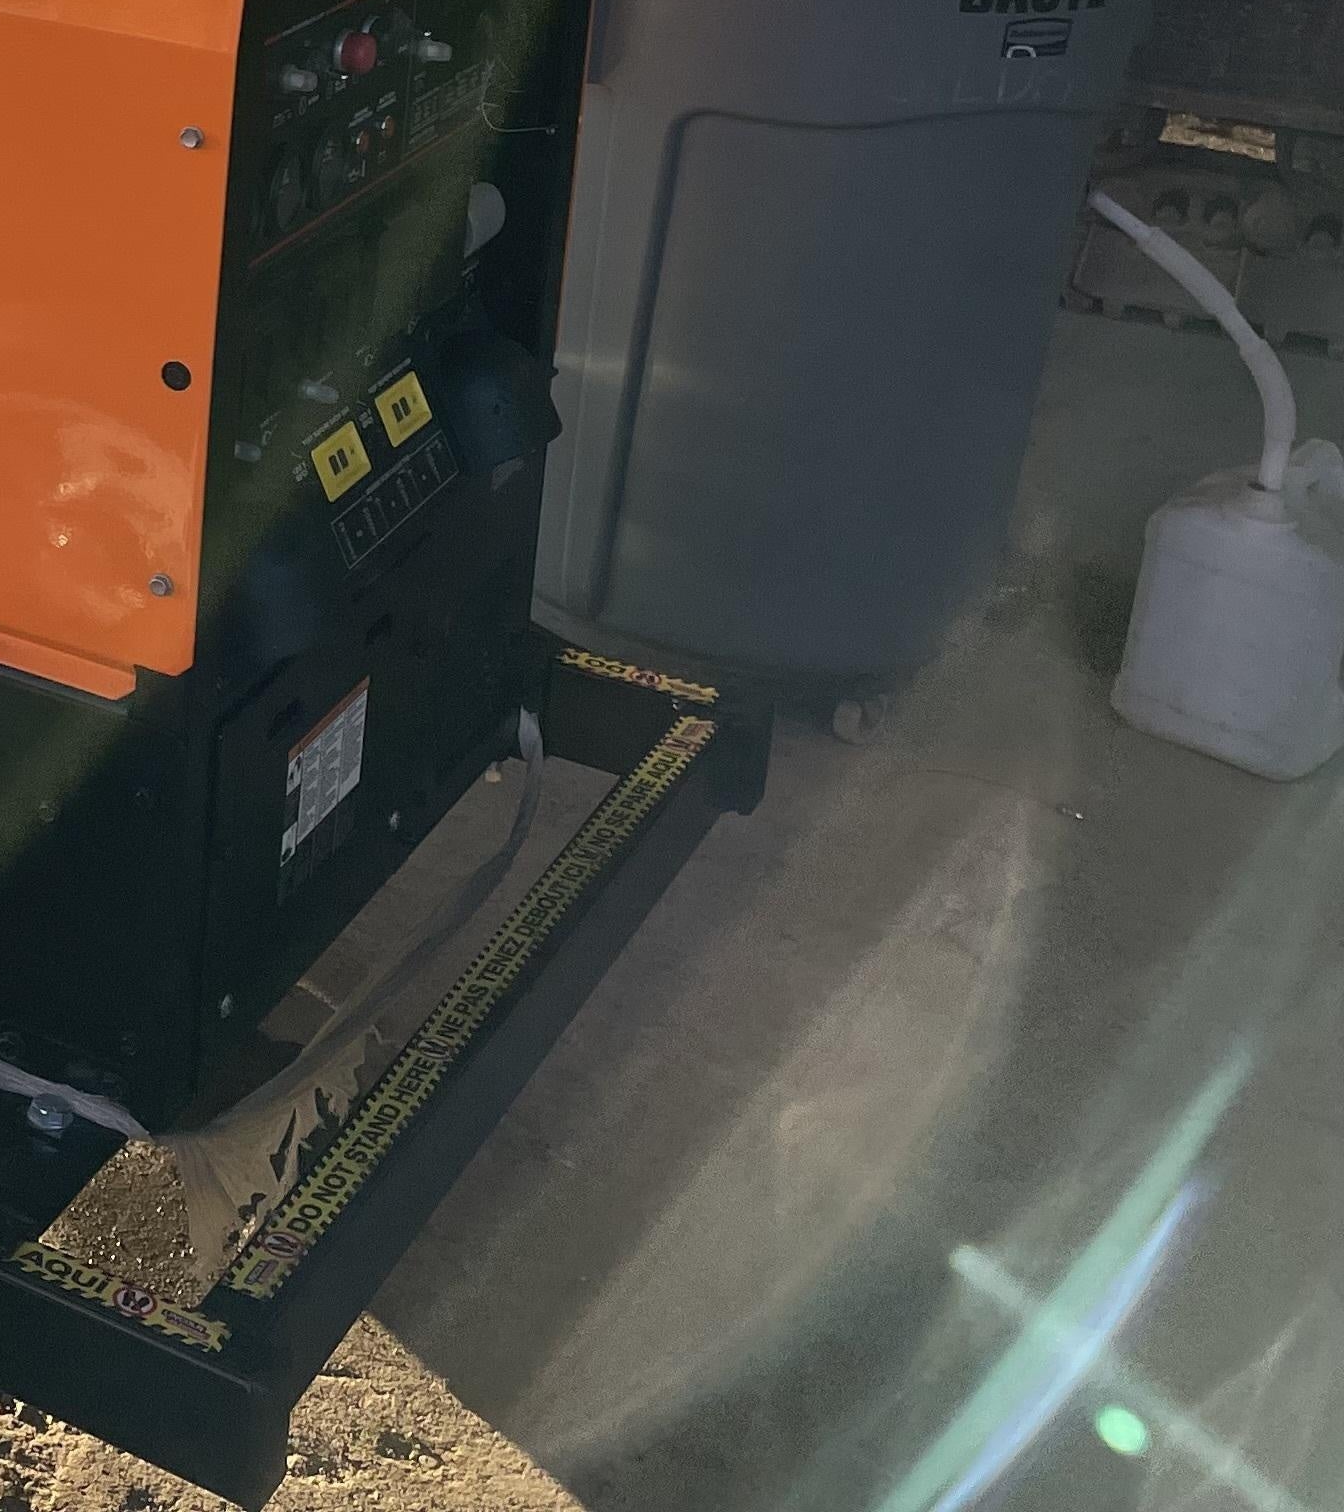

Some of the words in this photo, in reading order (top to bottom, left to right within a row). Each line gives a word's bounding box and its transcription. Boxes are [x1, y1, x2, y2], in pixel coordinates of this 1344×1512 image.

[287, 1203, 322, 1234] DO
[312, 1161, 356, 1204] NOT
[344, 1104, 401, 1164] STAND
[396, 1057, 437, 1104] HERE
[436, 1015, 464, 1039] NE
[453, 983, 489, 1016] PAS
[477, 936, 525, 983] TENEZ
[515, 887, 570, 938] DEBOUT
[593, 827, 617, 849] NO
[620, 774, 656, 811] PARE
[19, 1250, 110, 1292] AQUI
